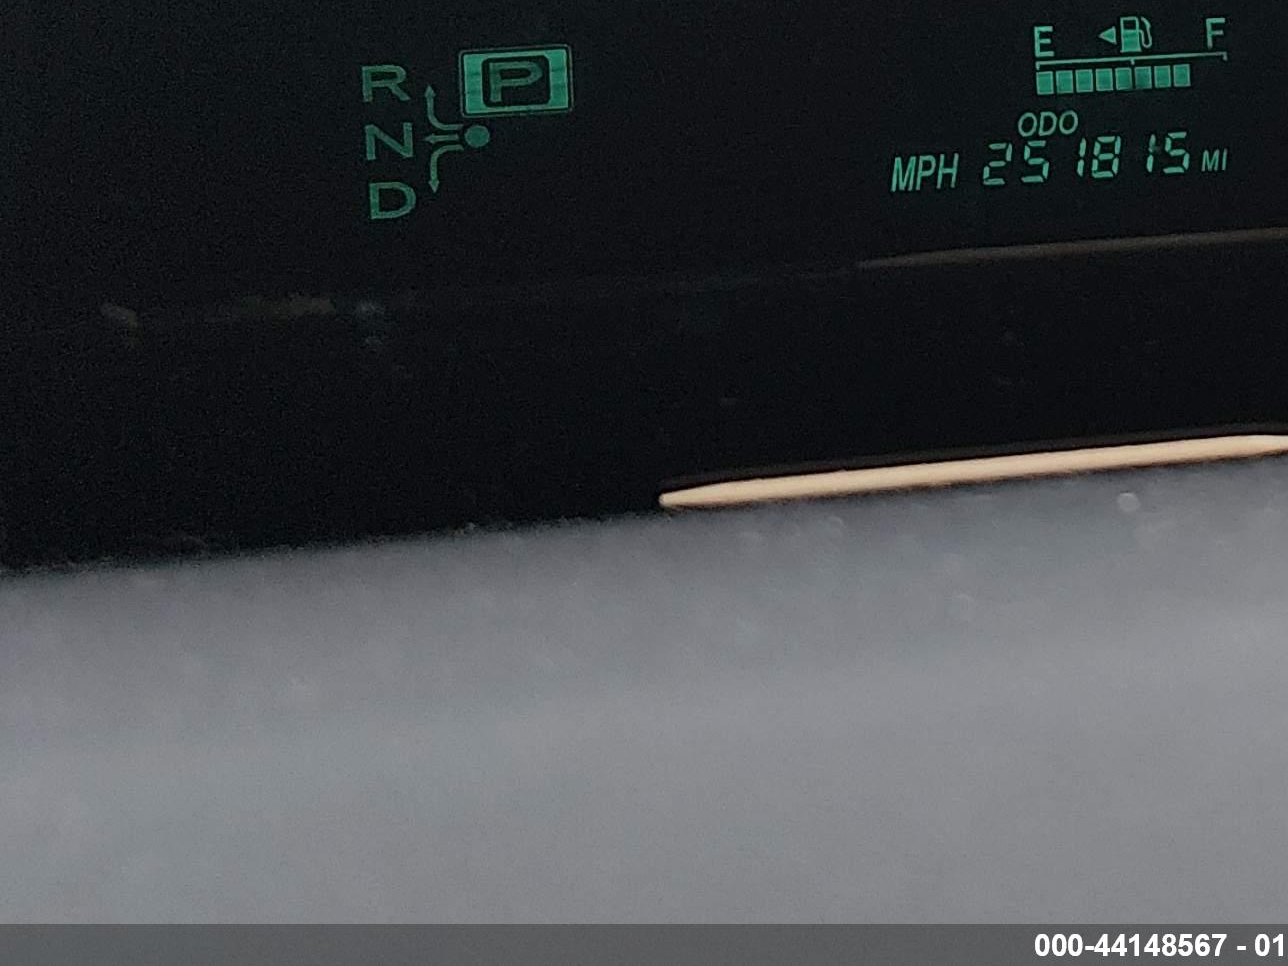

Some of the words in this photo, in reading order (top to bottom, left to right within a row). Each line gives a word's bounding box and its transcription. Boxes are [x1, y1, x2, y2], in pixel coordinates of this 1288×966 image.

[1033, 25, 1055, 58] E
[1205, 17, 1226, 48] F
[361, 64, 411, 103] R
[489, 60, 543, 103] P
[364, 122, 413, 161] N
[1017, 110, 1079, 137] ODO
[890, 152, 960, 192] MPH
[982, 131, 1191, 186] 251815
[1201, 148, 1228, 172] MI
[369, 181, 417, 220] D
